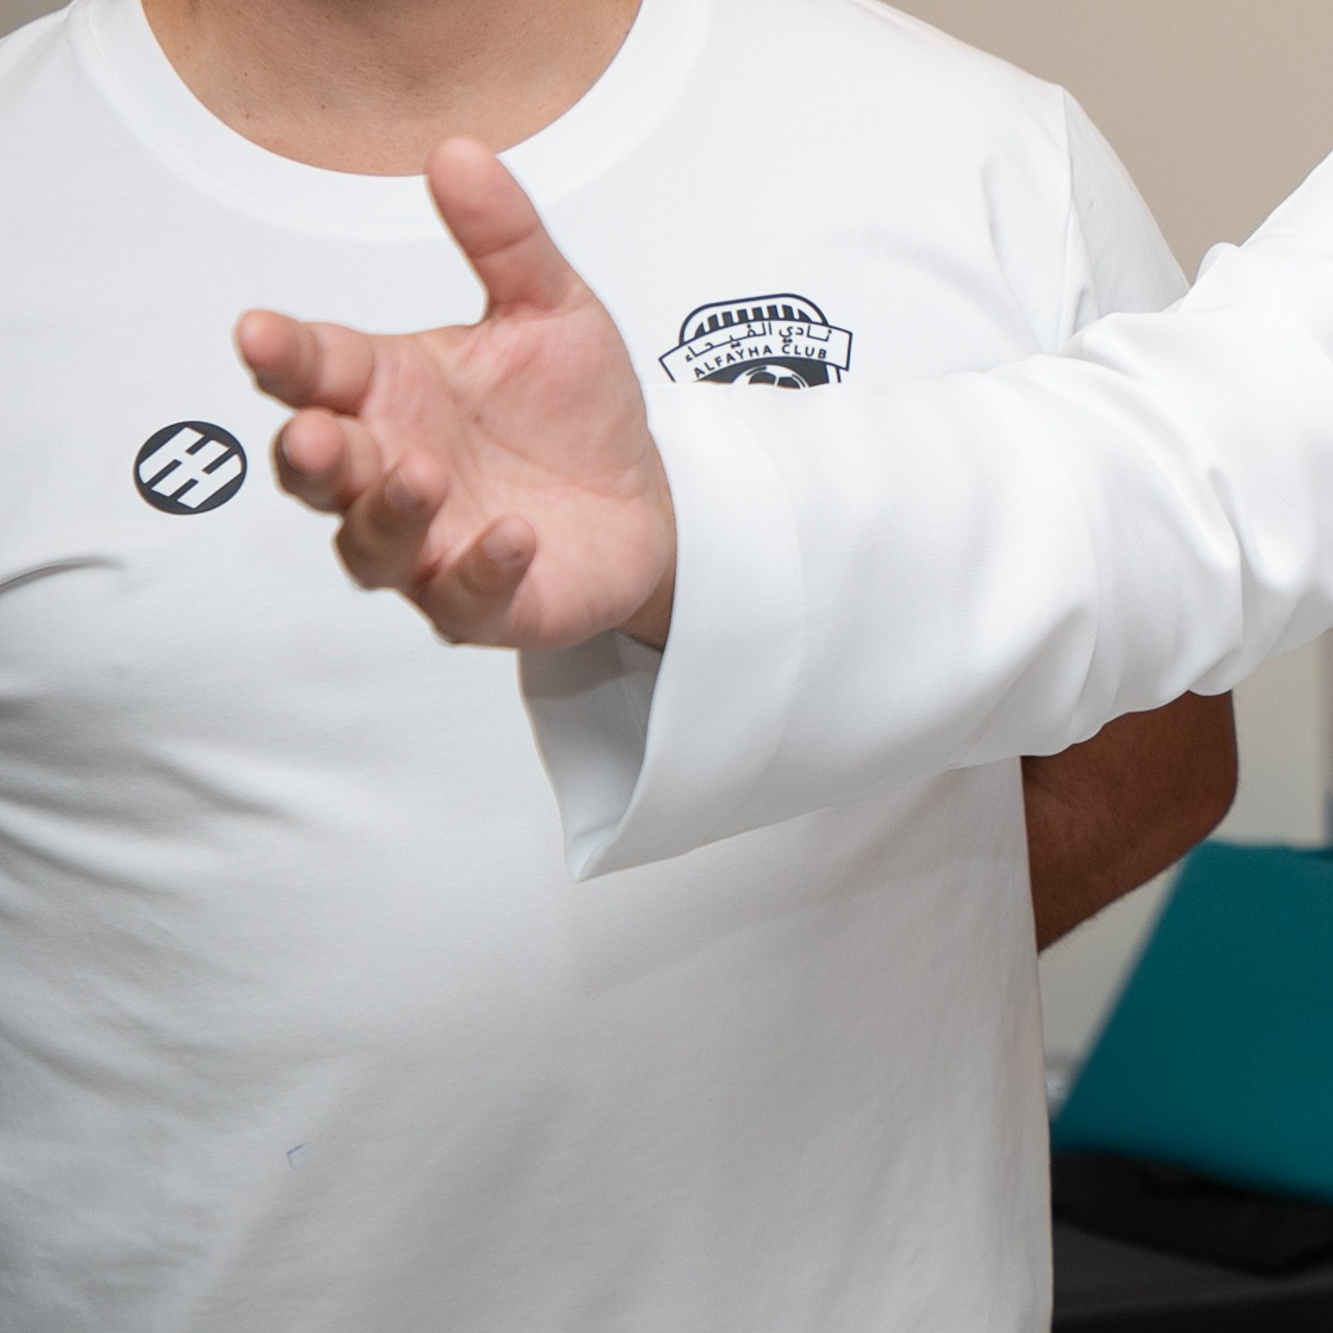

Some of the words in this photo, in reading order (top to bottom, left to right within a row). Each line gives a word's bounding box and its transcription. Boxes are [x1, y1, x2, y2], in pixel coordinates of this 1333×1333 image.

[685, 322, 773, 363] الفيحاء
[778, 324, 832, 344] نادي
[693, 345, 774, 378] ALFAYHA
[781, 343, 828, 360] CLUB
